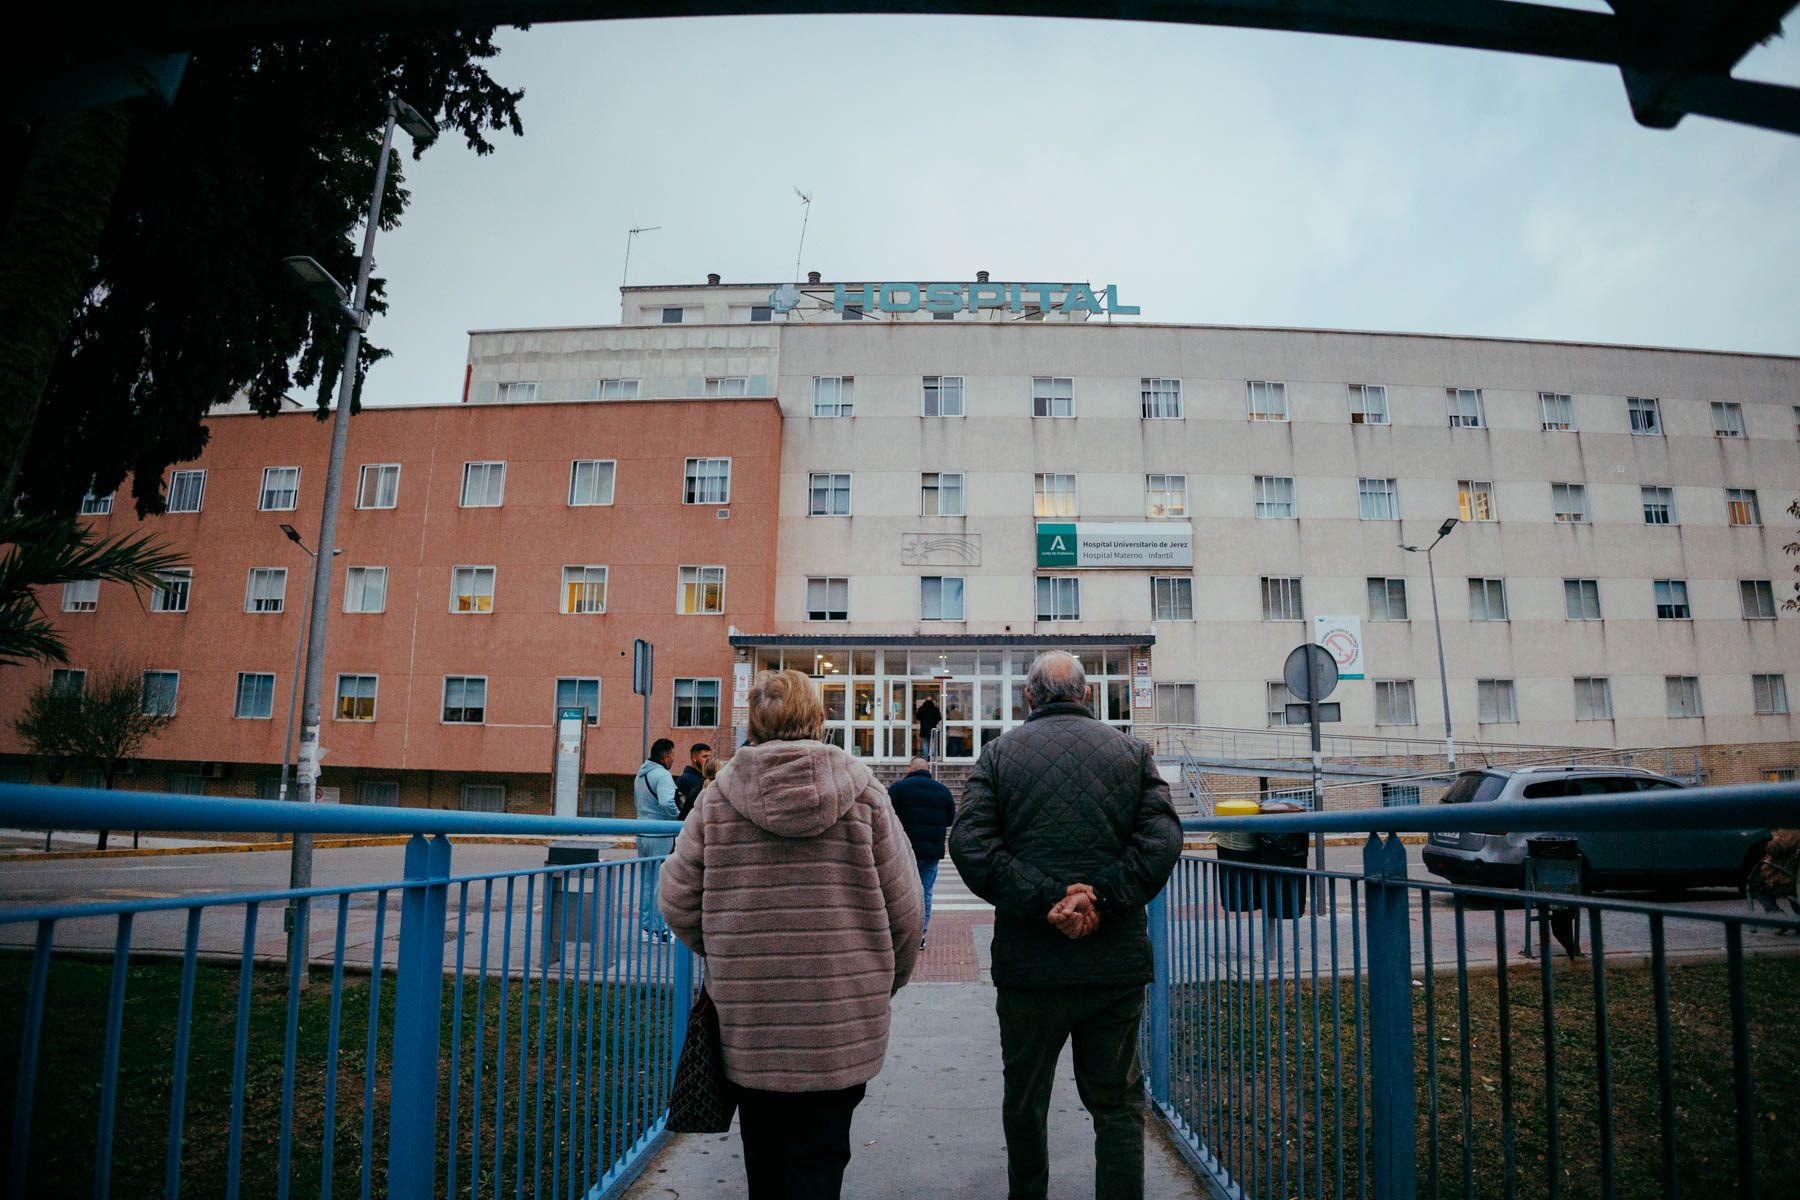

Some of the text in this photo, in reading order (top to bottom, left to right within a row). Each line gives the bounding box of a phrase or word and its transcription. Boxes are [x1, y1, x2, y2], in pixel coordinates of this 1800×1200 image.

[833, 283, 1141, 315] HOSPITAL
[1083, 541, 1112, 550] Hospital
[1083, 552, 1113, 561] Hospital
